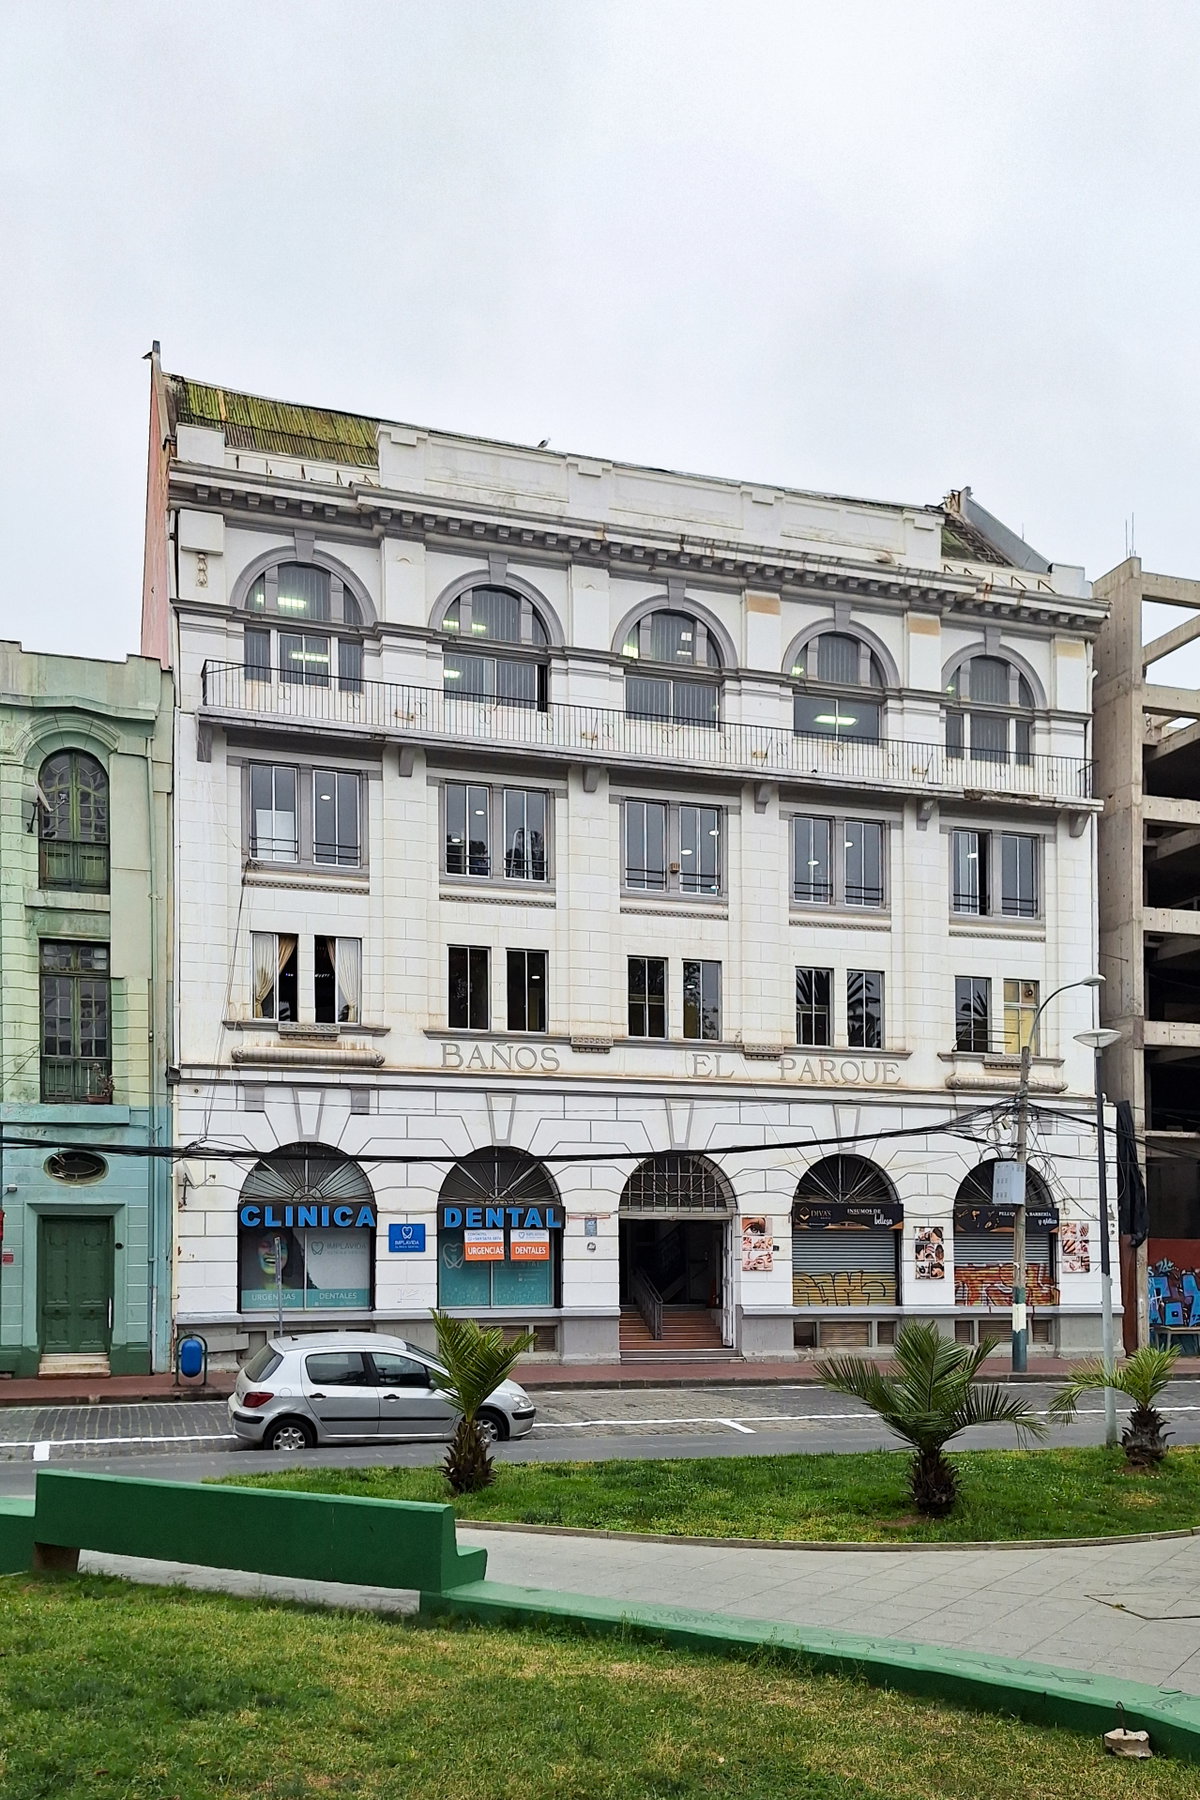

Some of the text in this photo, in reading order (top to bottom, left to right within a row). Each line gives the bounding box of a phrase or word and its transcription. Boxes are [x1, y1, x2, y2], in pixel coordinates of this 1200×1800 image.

[440, 1042, 902, 1085] BAÑOS EL PARQUE
[240, 1205, 376, 1227] CLINICA
[444, 1207, 562, 1228] DENTAL
[467, 1246, 546, 1255] URGENCIAS DENTALES
